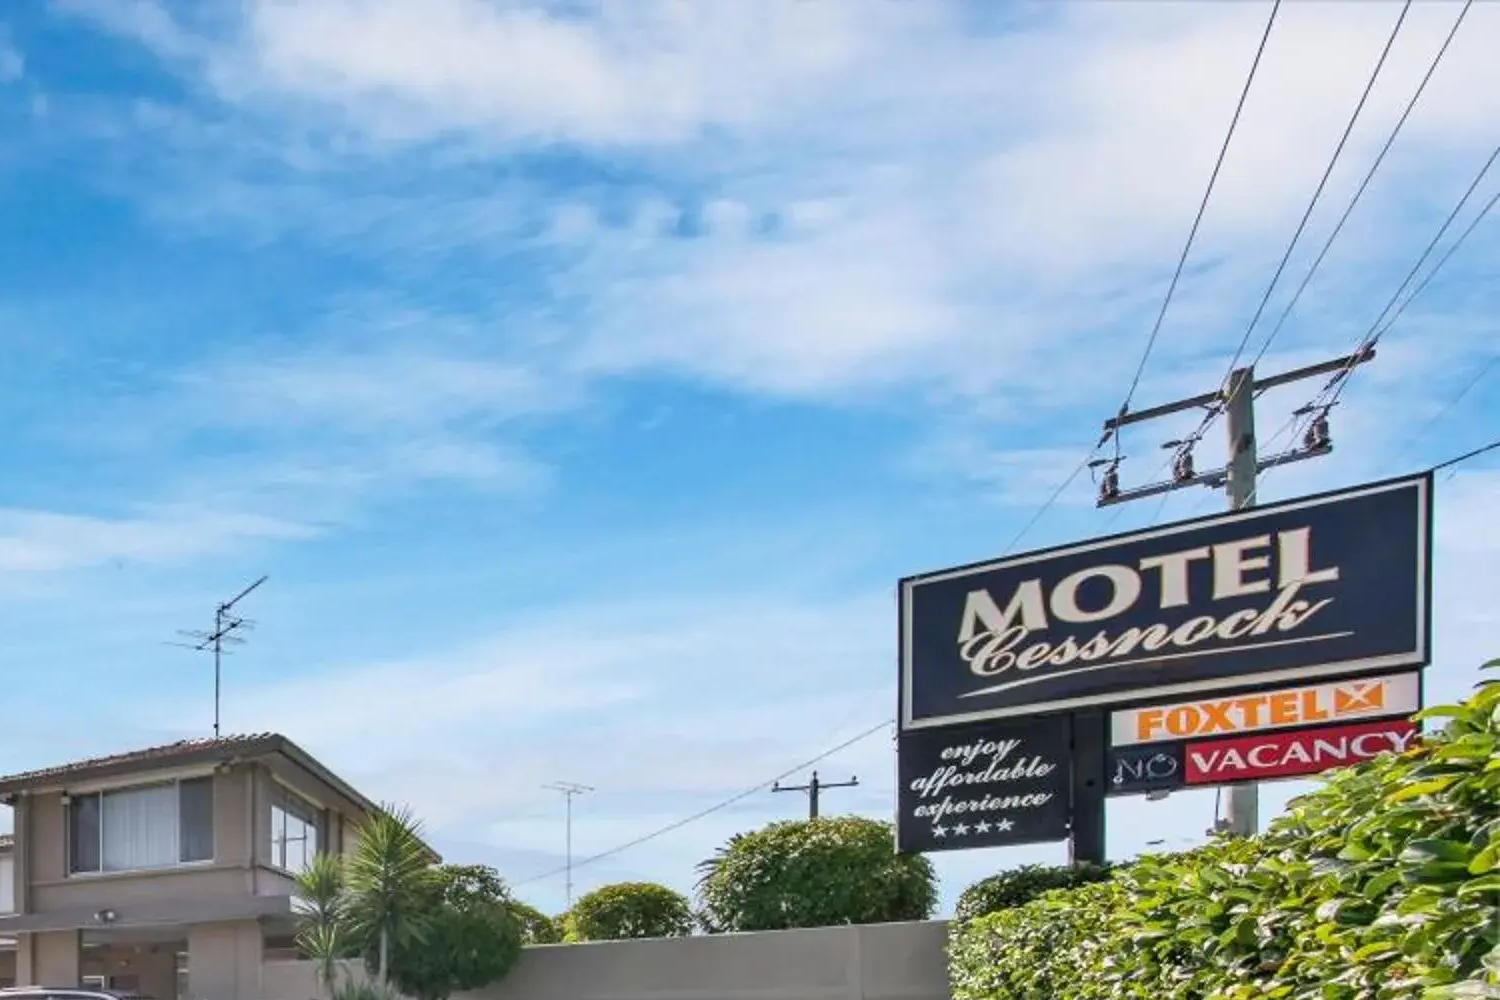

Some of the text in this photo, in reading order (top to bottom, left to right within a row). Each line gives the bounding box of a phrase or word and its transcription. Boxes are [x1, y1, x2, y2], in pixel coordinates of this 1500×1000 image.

[957, 526, 1339, 643] MOTEL
[960, 580, 1334, 676] Cessnock
[1136, 689, 1327, 741] FOXTEL
[910, 755, 1056, 798] affordable
[940, 738, 1021, 766] enjoy
[1112, 728, 1416, 783] NO VACANCY
[913, 792, 1053, 824] experience
